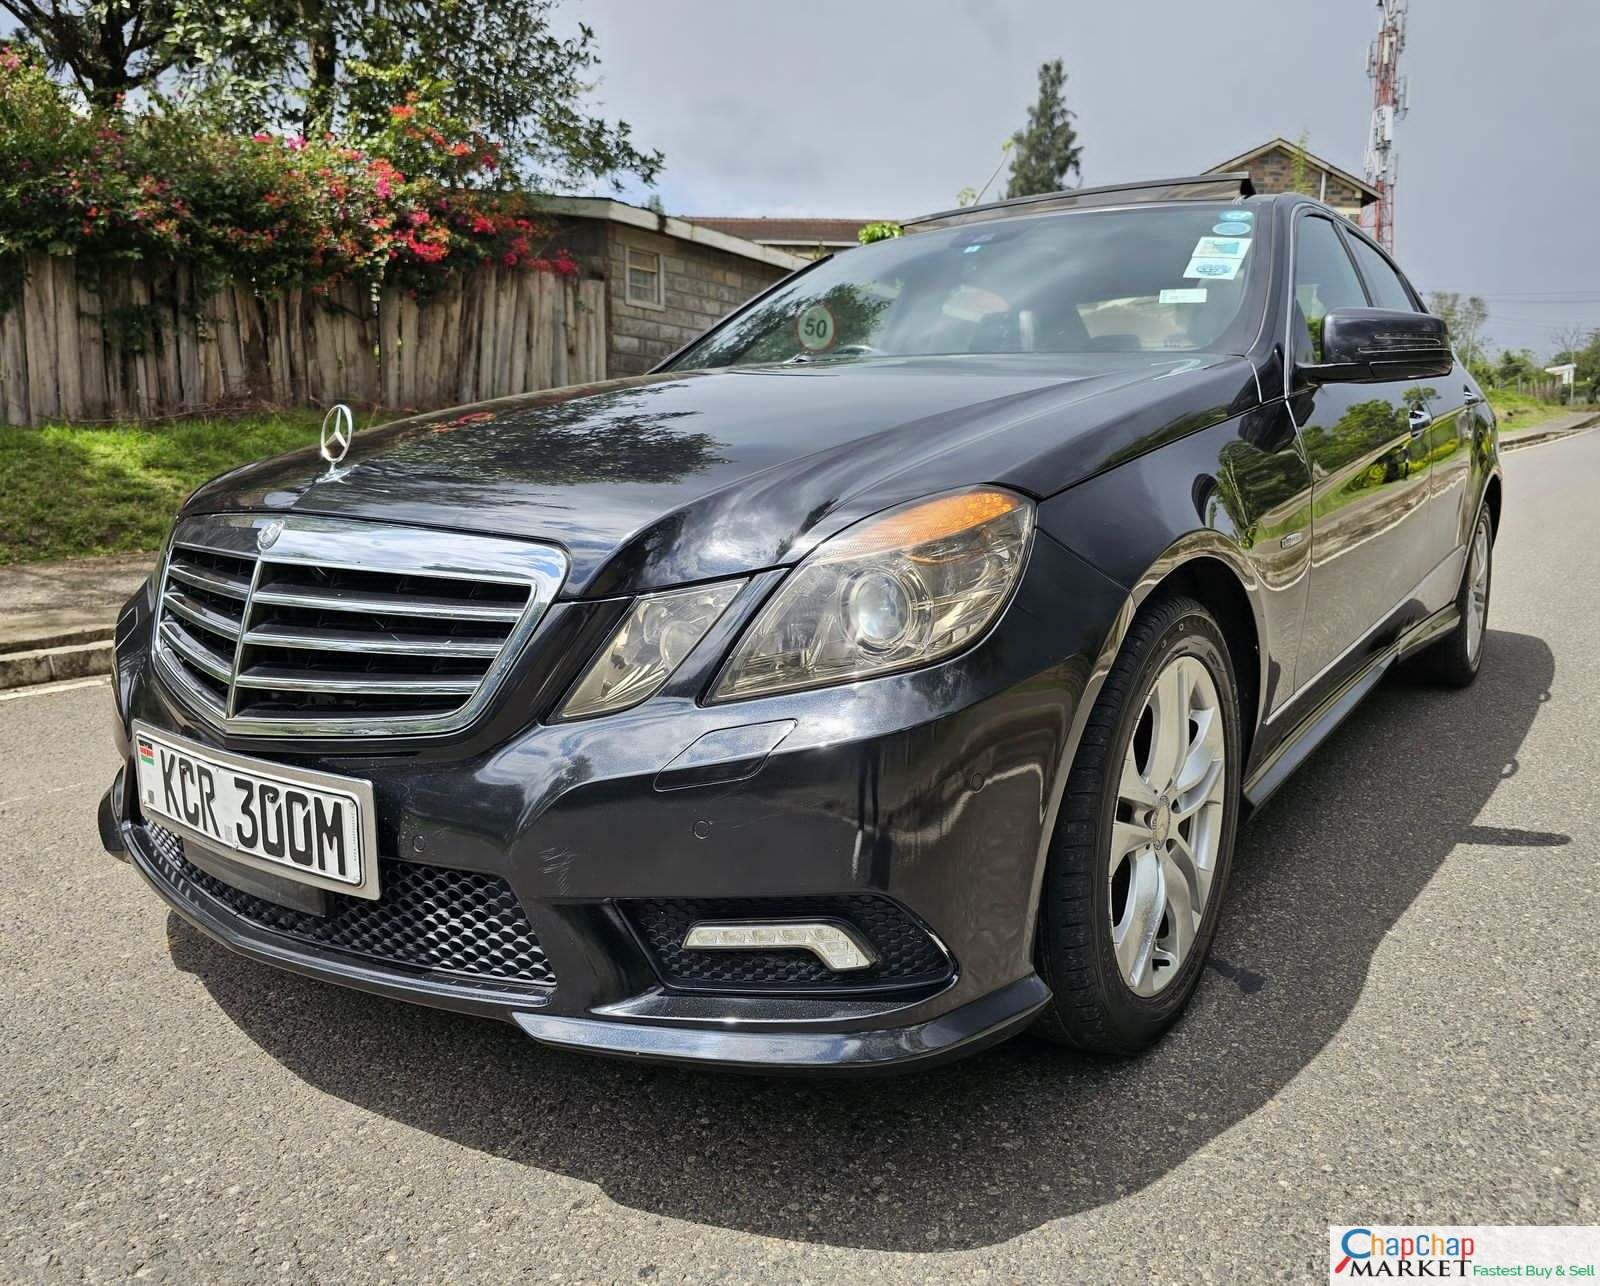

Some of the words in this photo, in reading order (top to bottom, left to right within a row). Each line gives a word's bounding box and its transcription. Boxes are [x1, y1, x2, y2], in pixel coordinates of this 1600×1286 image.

[804, 318, 828, 338] 50
[159, 748, 222, 839] KCR
[233, 776, 347, 877] 300M
